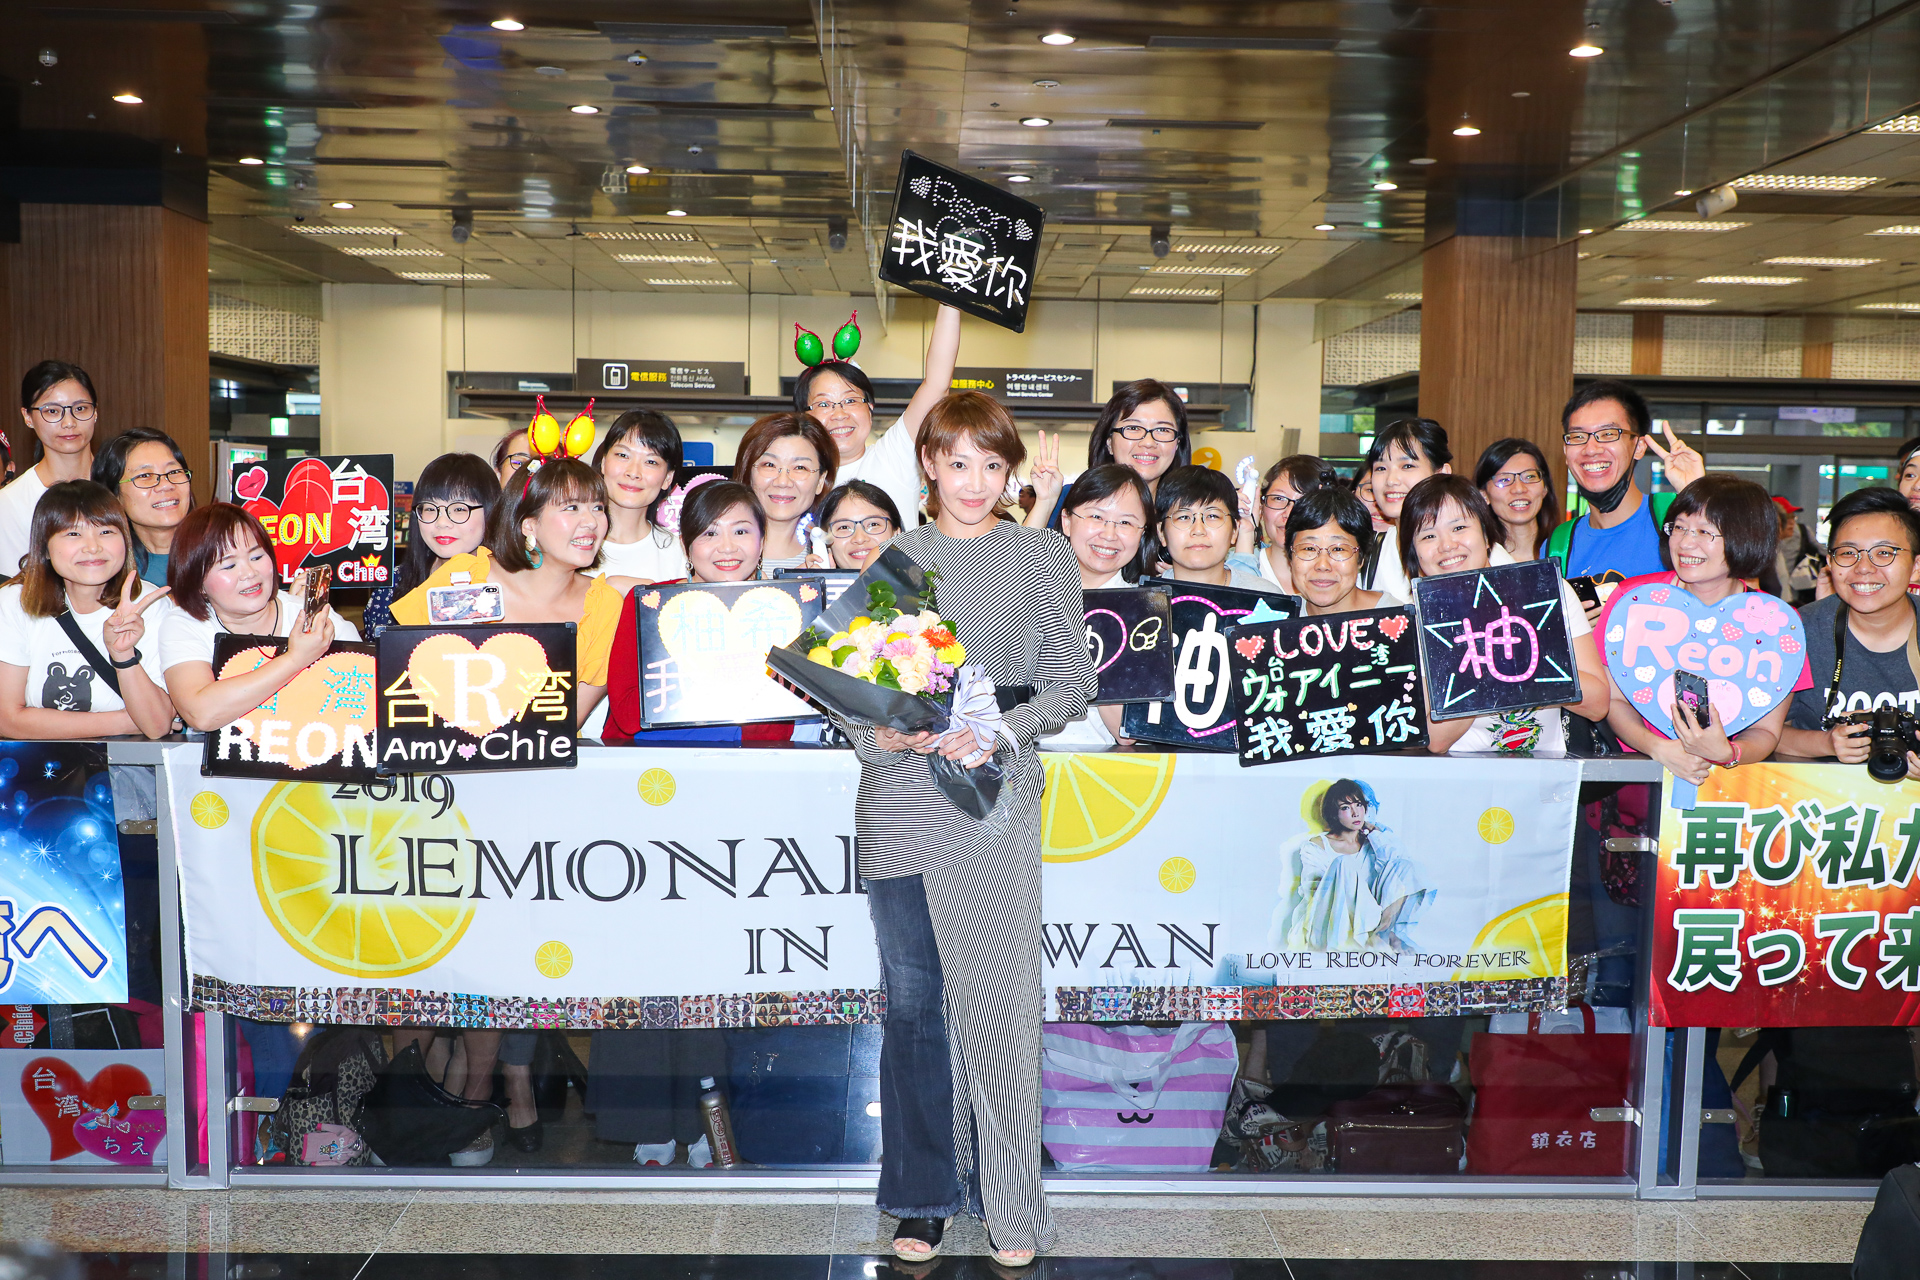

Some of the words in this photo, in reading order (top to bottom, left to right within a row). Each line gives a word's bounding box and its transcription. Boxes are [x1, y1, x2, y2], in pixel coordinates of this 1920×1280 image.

[891, 216, 1026, 308] 我愛你
[631, 372, 667, 382] 電信服務
[950, 379, 995, 389] 遊服務中心
[1006, 374, 1082, 382] トラベルサービスセンター
[330, 458, 390, 551] 台湾
[259, 513, 332, 546] EON
[1273, 618, 1375, 659] LOVE
[1453, 605, 1539, 683] 柚
[1622, 604, 1782, 683] Reon
[384, 670, 440, 727] 台
[442, 653, 514, 729] R
[1834, 659, 1842, 682] Nikon
[217, 718, 377, 769] REON
[383, 737, 457, 764] Amy
[480, 729, 572, 760] Chie
[1248, 699, 1420, 760] 我愛你
[744, 925, 834, 975] IN
[1041, 923, 1221, 969] WAN
[1246, 952, 1312, 969] LOVE
[1326, 951, 1399, 968] REON
[1413, 950, 1531, 969] FOREVER
[103, 1136, 149, 1155] ちえ
